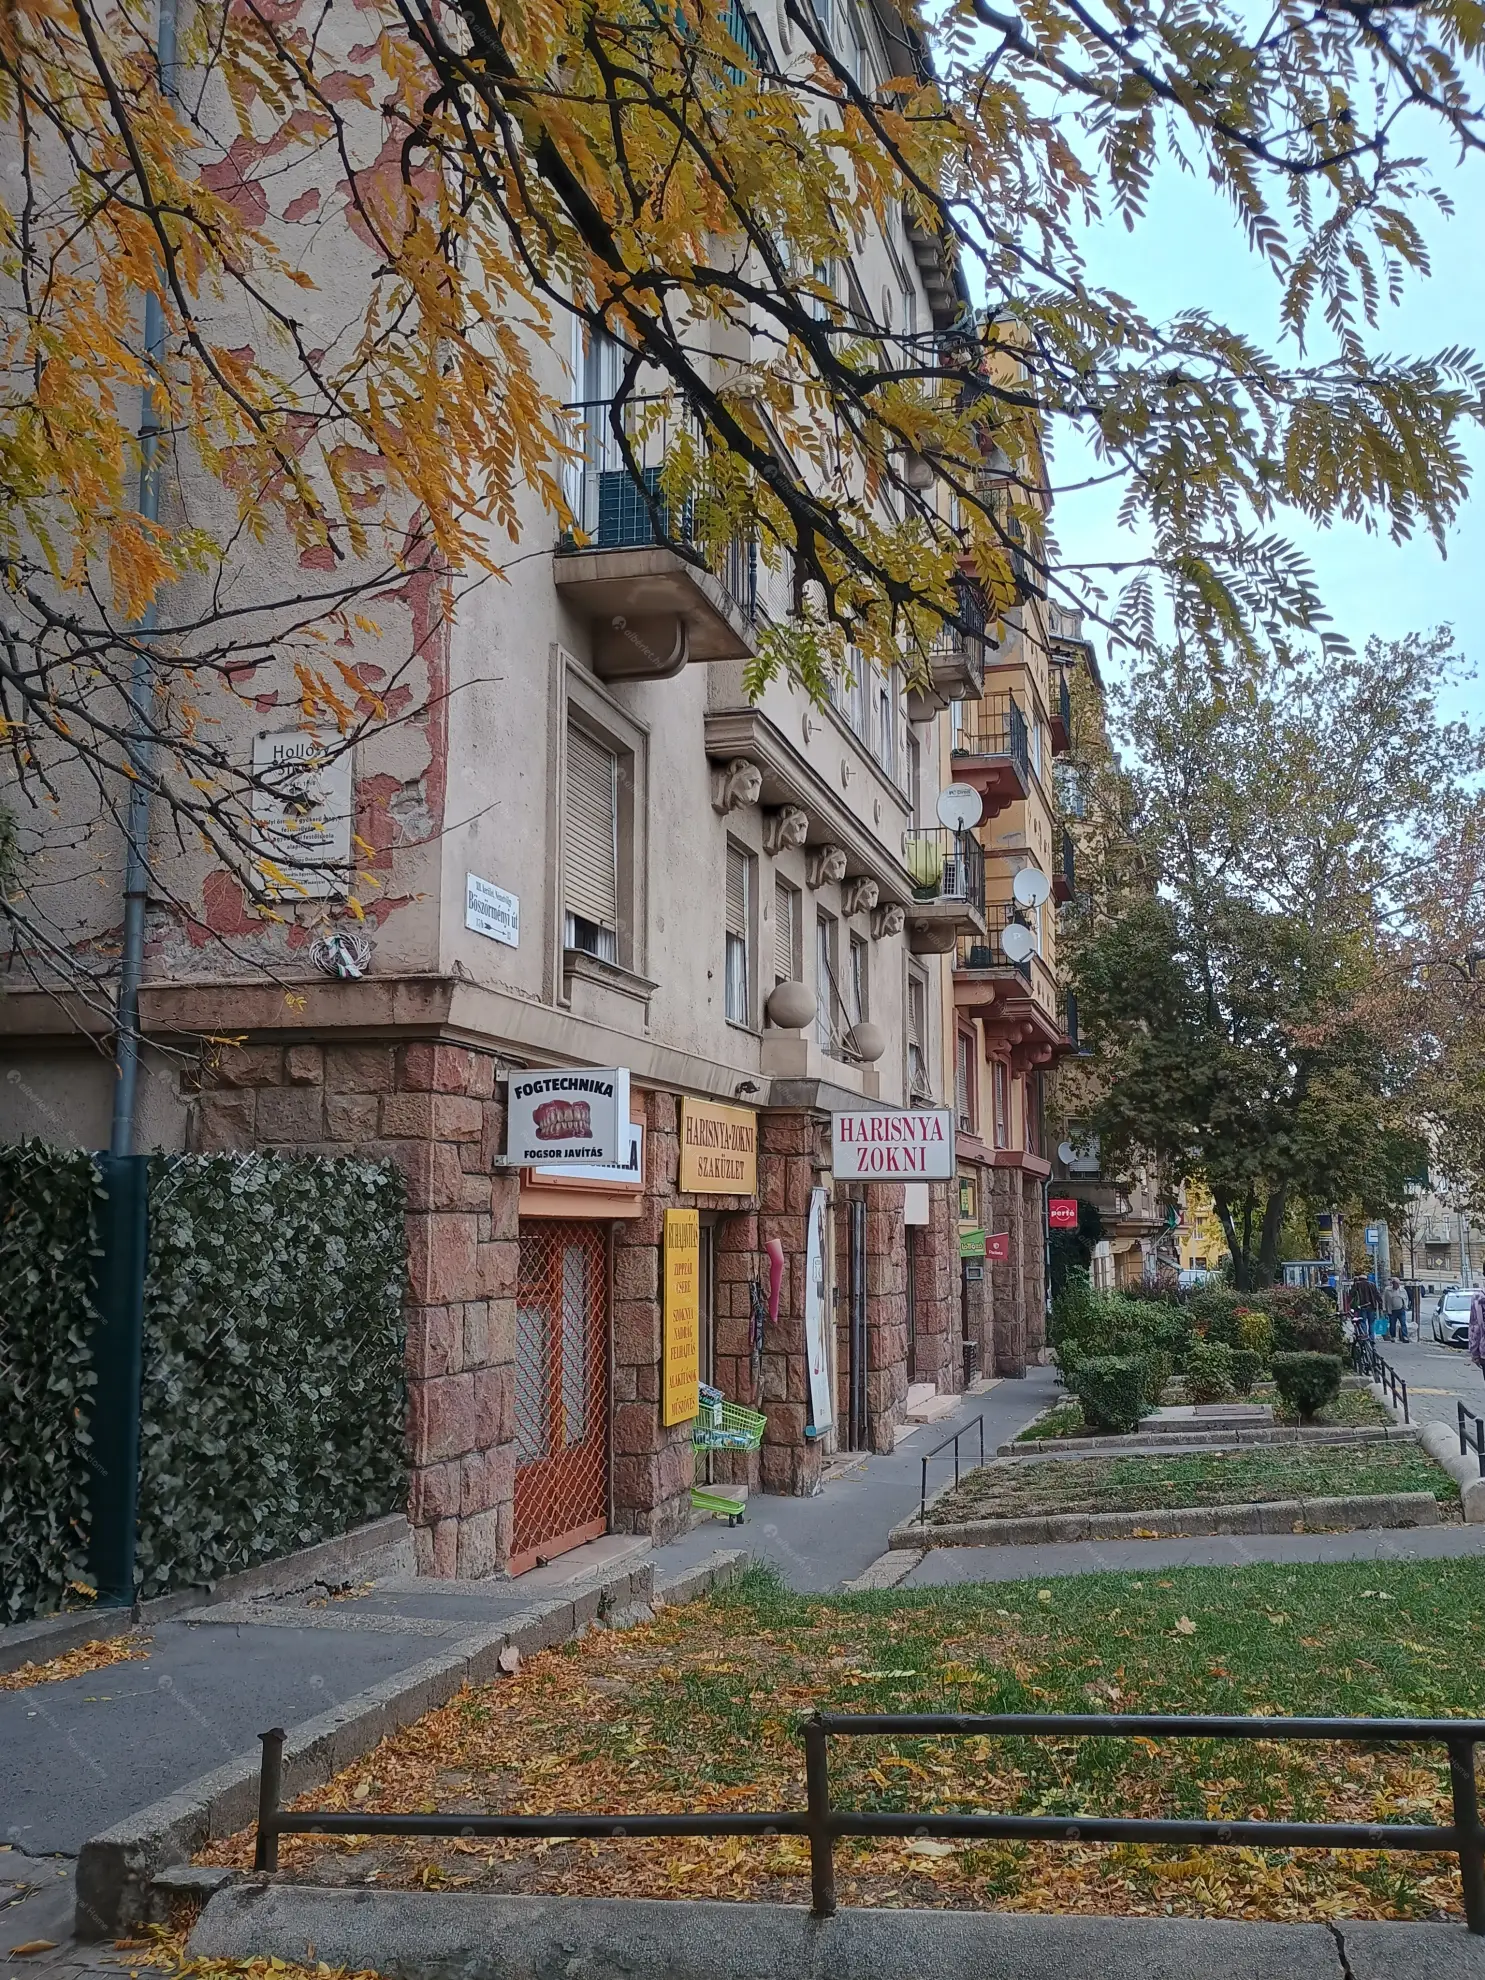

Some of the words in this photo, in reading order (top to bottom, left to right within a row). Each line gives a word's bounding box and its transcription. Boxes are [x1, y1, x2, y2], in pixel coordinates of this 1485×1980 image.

[273, 743, 329, 760] Hollóy
[468, 889, 510, 928] Böszörményi
[511, 911, 518, 930] út
[514, 1077, 614, 1100] FOGTECHNIKA
[840, 1116, 944, 1143] HARISNYA
[524, 1150, 562, 1159] FOGSOR
[564, 1146, 603, 1158] JAVÍTÁS
[857, 1146, 927, 1172] ZOKNI
[698, 1154, 745, 1180] SZAKÜZLET
[674, 1258, 693, 1276] ZIPPZÁR
[675, 1280, 691, 1294] CSERE
[673, 1307, 694, 1322] SZOKNYA
[674, 1321, 693, 1340] NADRÁG
[670, 1340, 696, 1361] FELHAJTÁS
[669, 1366, 697, 1389] ALAKÍTÁSOK
